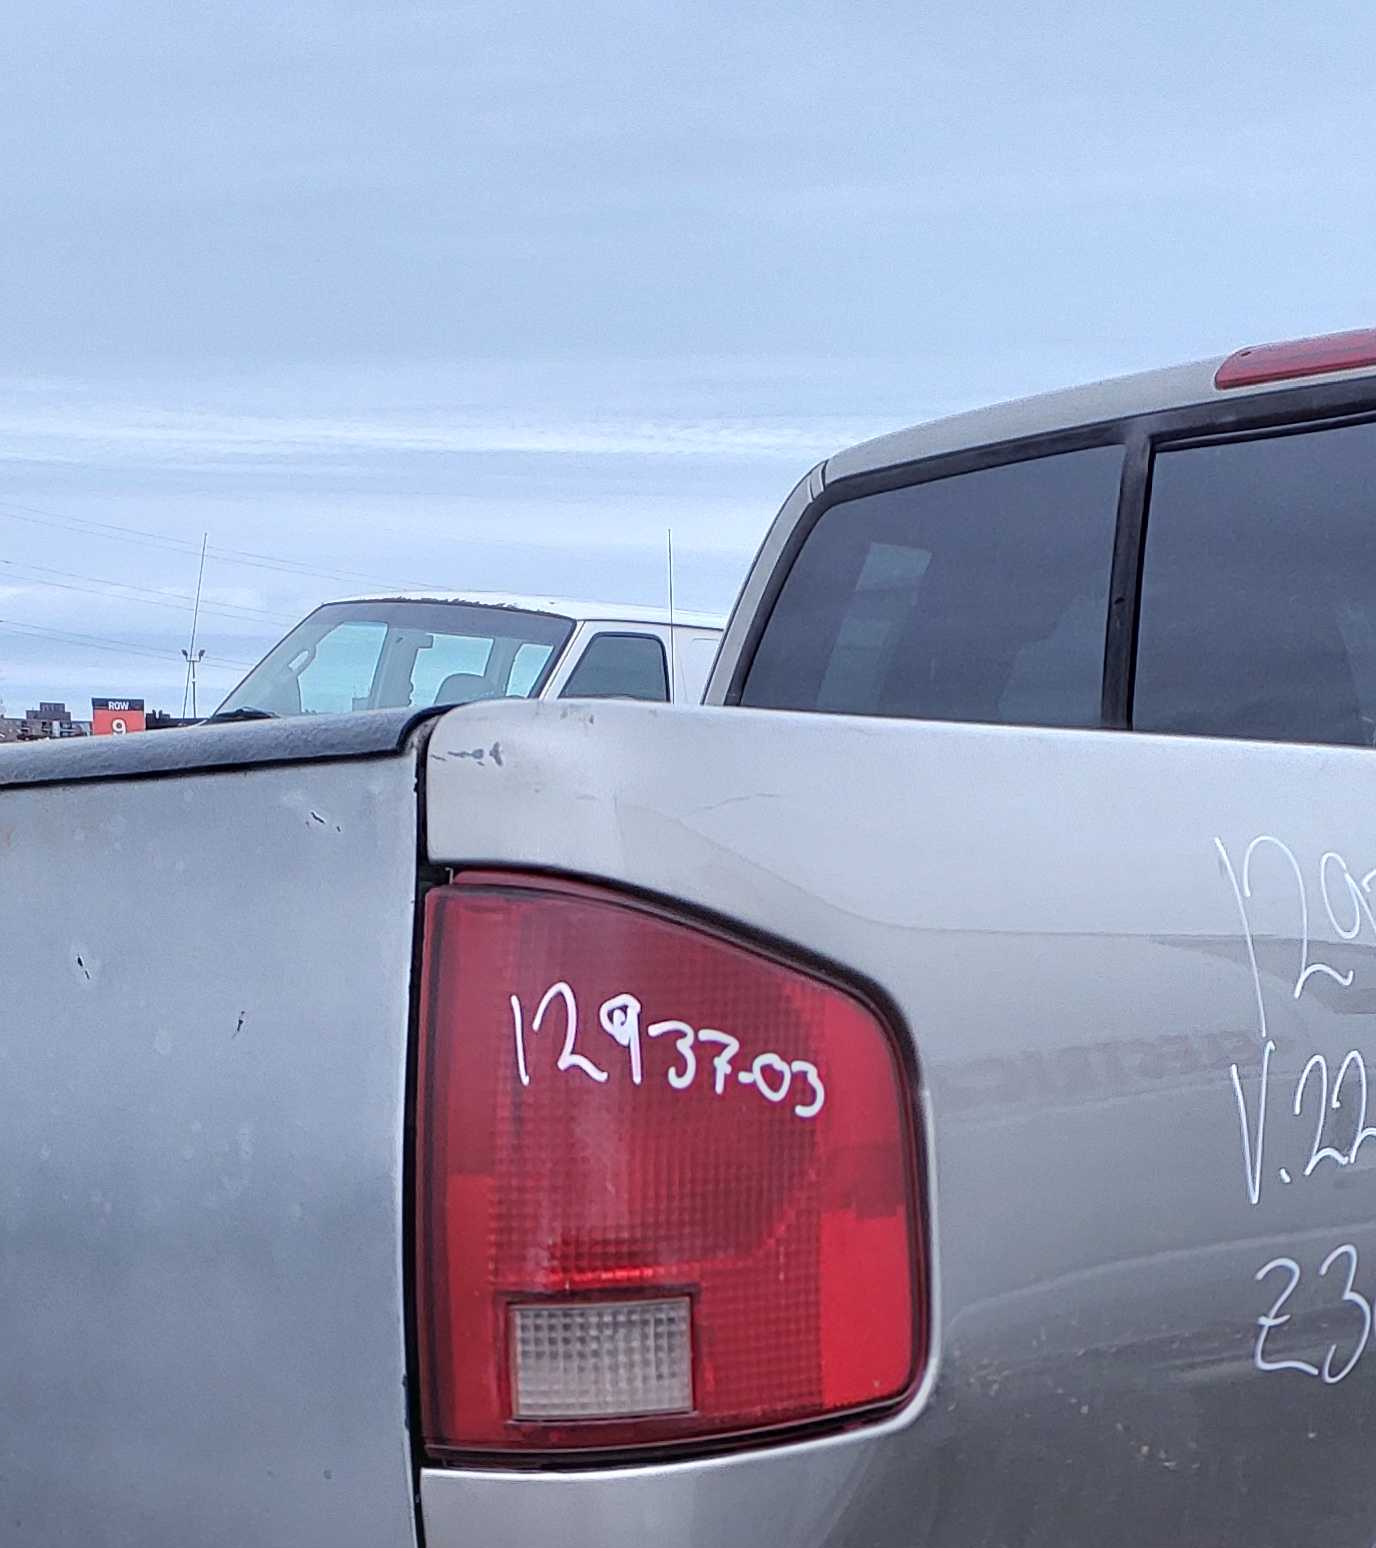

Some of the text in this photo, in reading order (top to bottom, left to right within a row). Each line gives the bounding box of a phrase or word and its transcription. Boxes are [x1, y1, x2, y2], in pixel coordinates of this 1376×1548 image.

[108, 701, 130, 712] ROW
[112, 719, 127, 736] 9
[510, 982, 825, 1118] 12937-03
